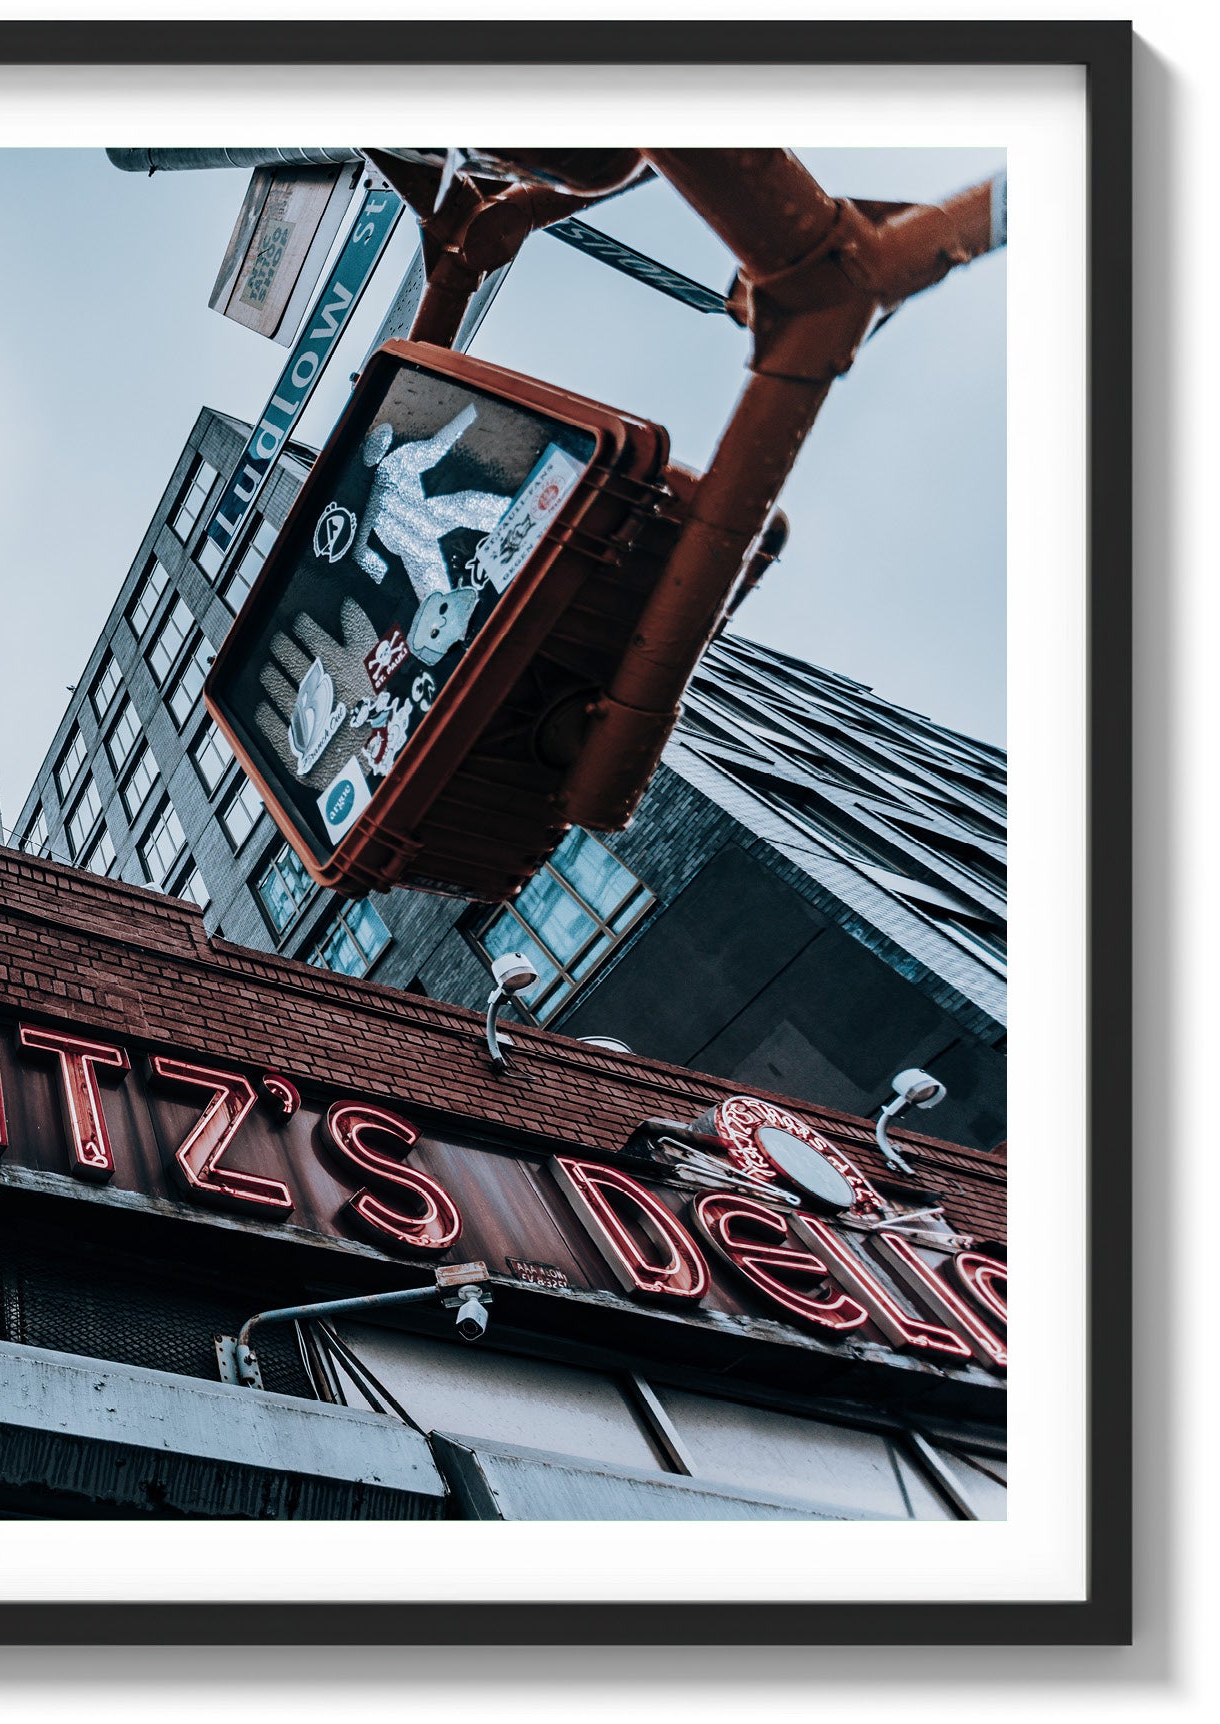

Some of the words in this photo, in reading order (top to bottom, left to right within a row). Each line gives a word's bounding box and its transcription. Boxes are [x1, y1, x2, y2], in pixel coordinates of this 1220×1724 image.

[248, 227, 282, 300] TATTOO
[258, 228, 289, 303] SHOP
[555, 225, 703, 290] HOUS
[216, 282, 353, 537] Ludlow
[352, 196, 387, 247] St
[329, 784, 352, 821] argue
